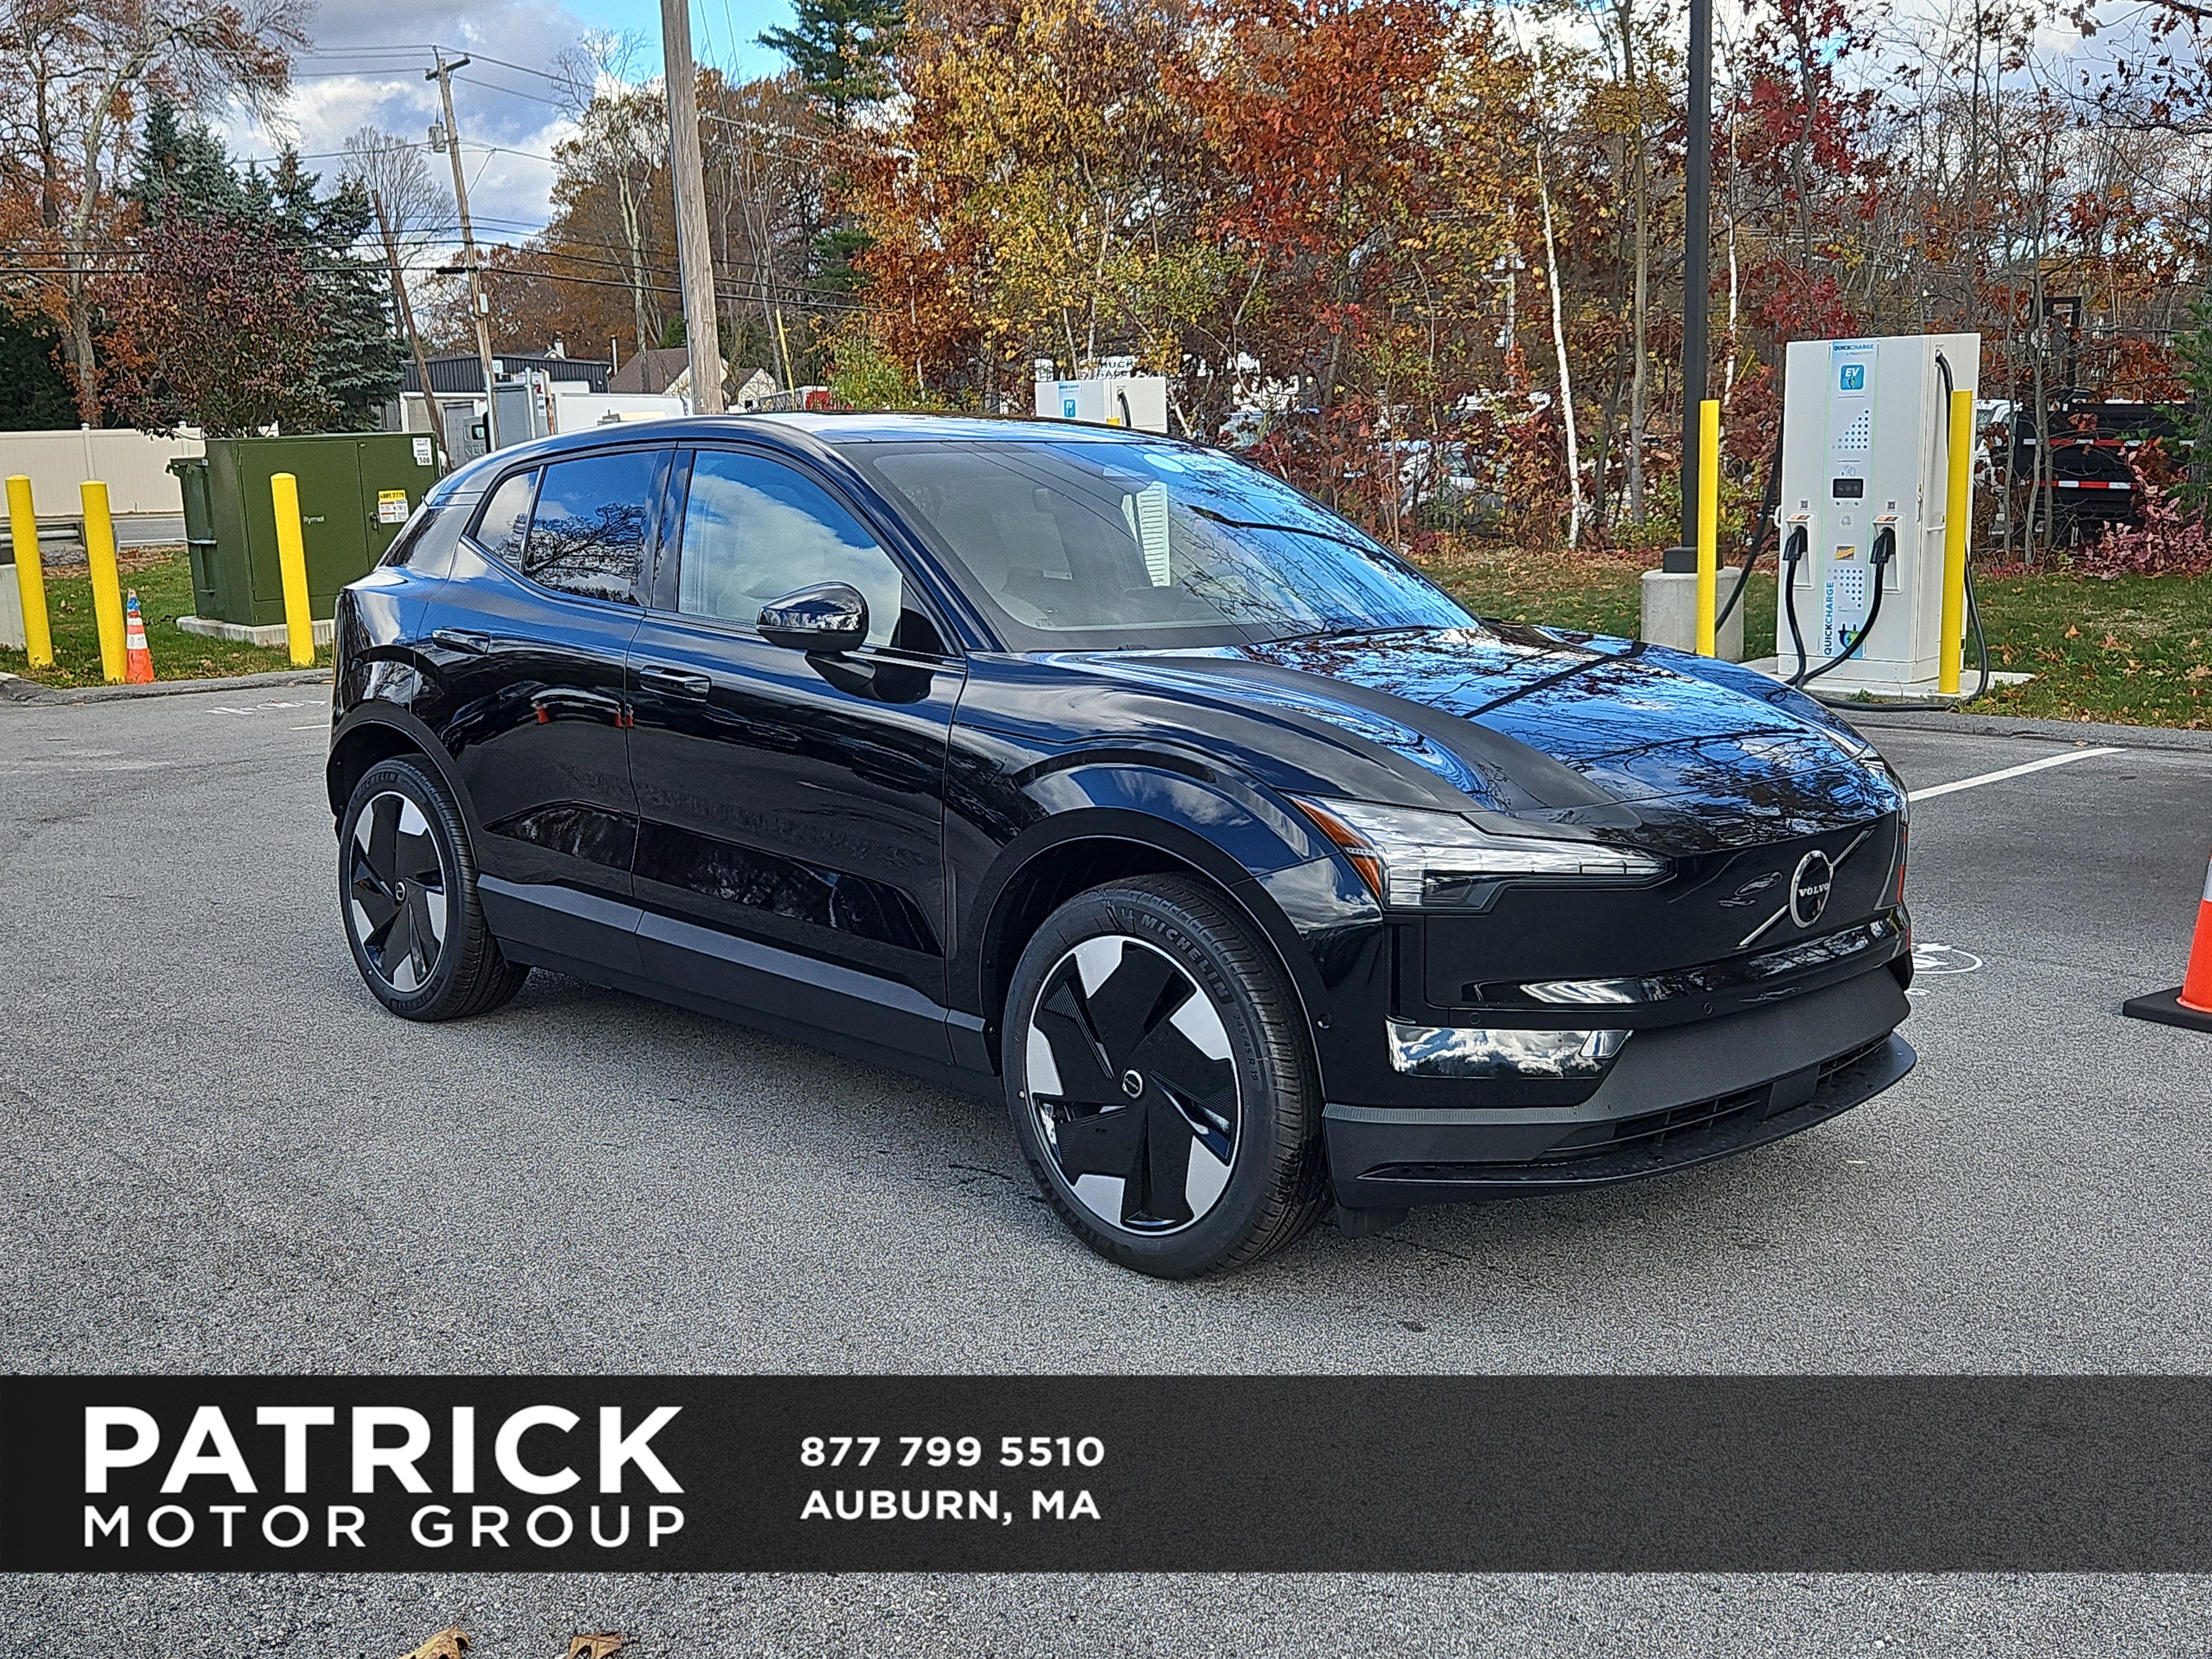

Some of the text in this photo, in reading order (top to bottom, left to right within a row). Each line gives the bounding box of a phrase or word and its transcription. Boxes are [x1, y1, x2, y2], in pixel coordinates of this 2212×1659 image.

[1844, 367, 1860, 377] EV
[1824, 581, 1834, 655] QUICKCHARGE
[1798, 883, 1829, 897] VOLVO
[1140, 913, 1230, 1002] MICHELIN
[1233, 1015, 1252, 1053] 245/45
